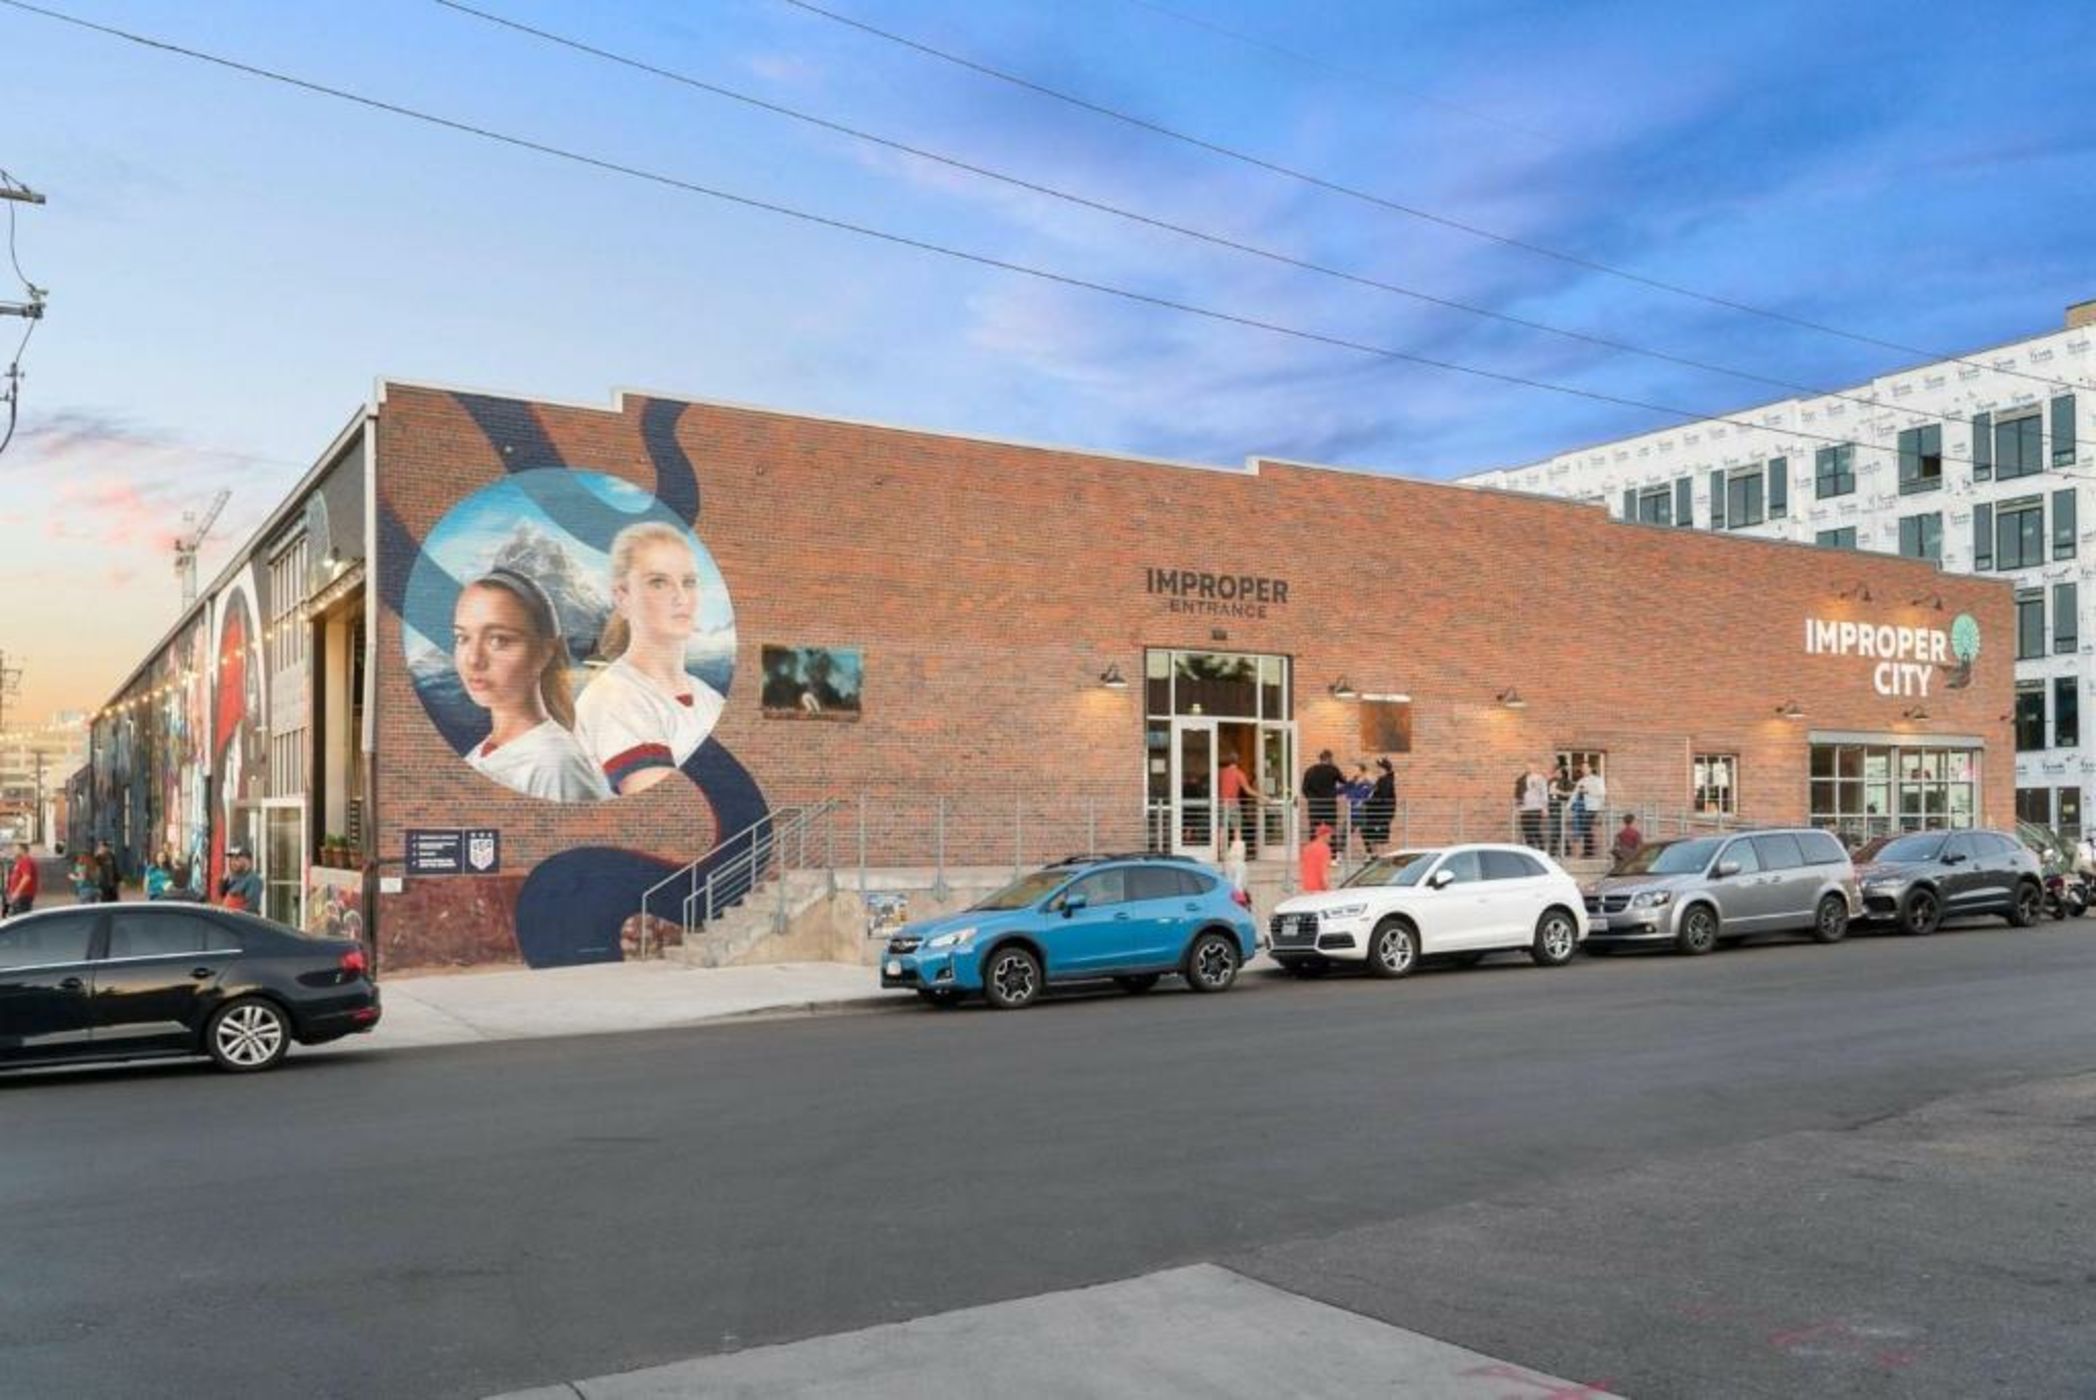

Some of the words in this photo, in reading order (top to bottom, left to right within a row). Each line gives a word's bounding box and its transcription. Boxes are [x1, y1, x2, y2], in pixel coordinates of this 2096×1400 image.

[1147, 568, 1288, 604] IMPROPER
[1170, 599, 1268, 619] ENTRANCE
[1805, 618, 1947, 662] IMPROPER
[1874, 661, 1932, 697] CITY
